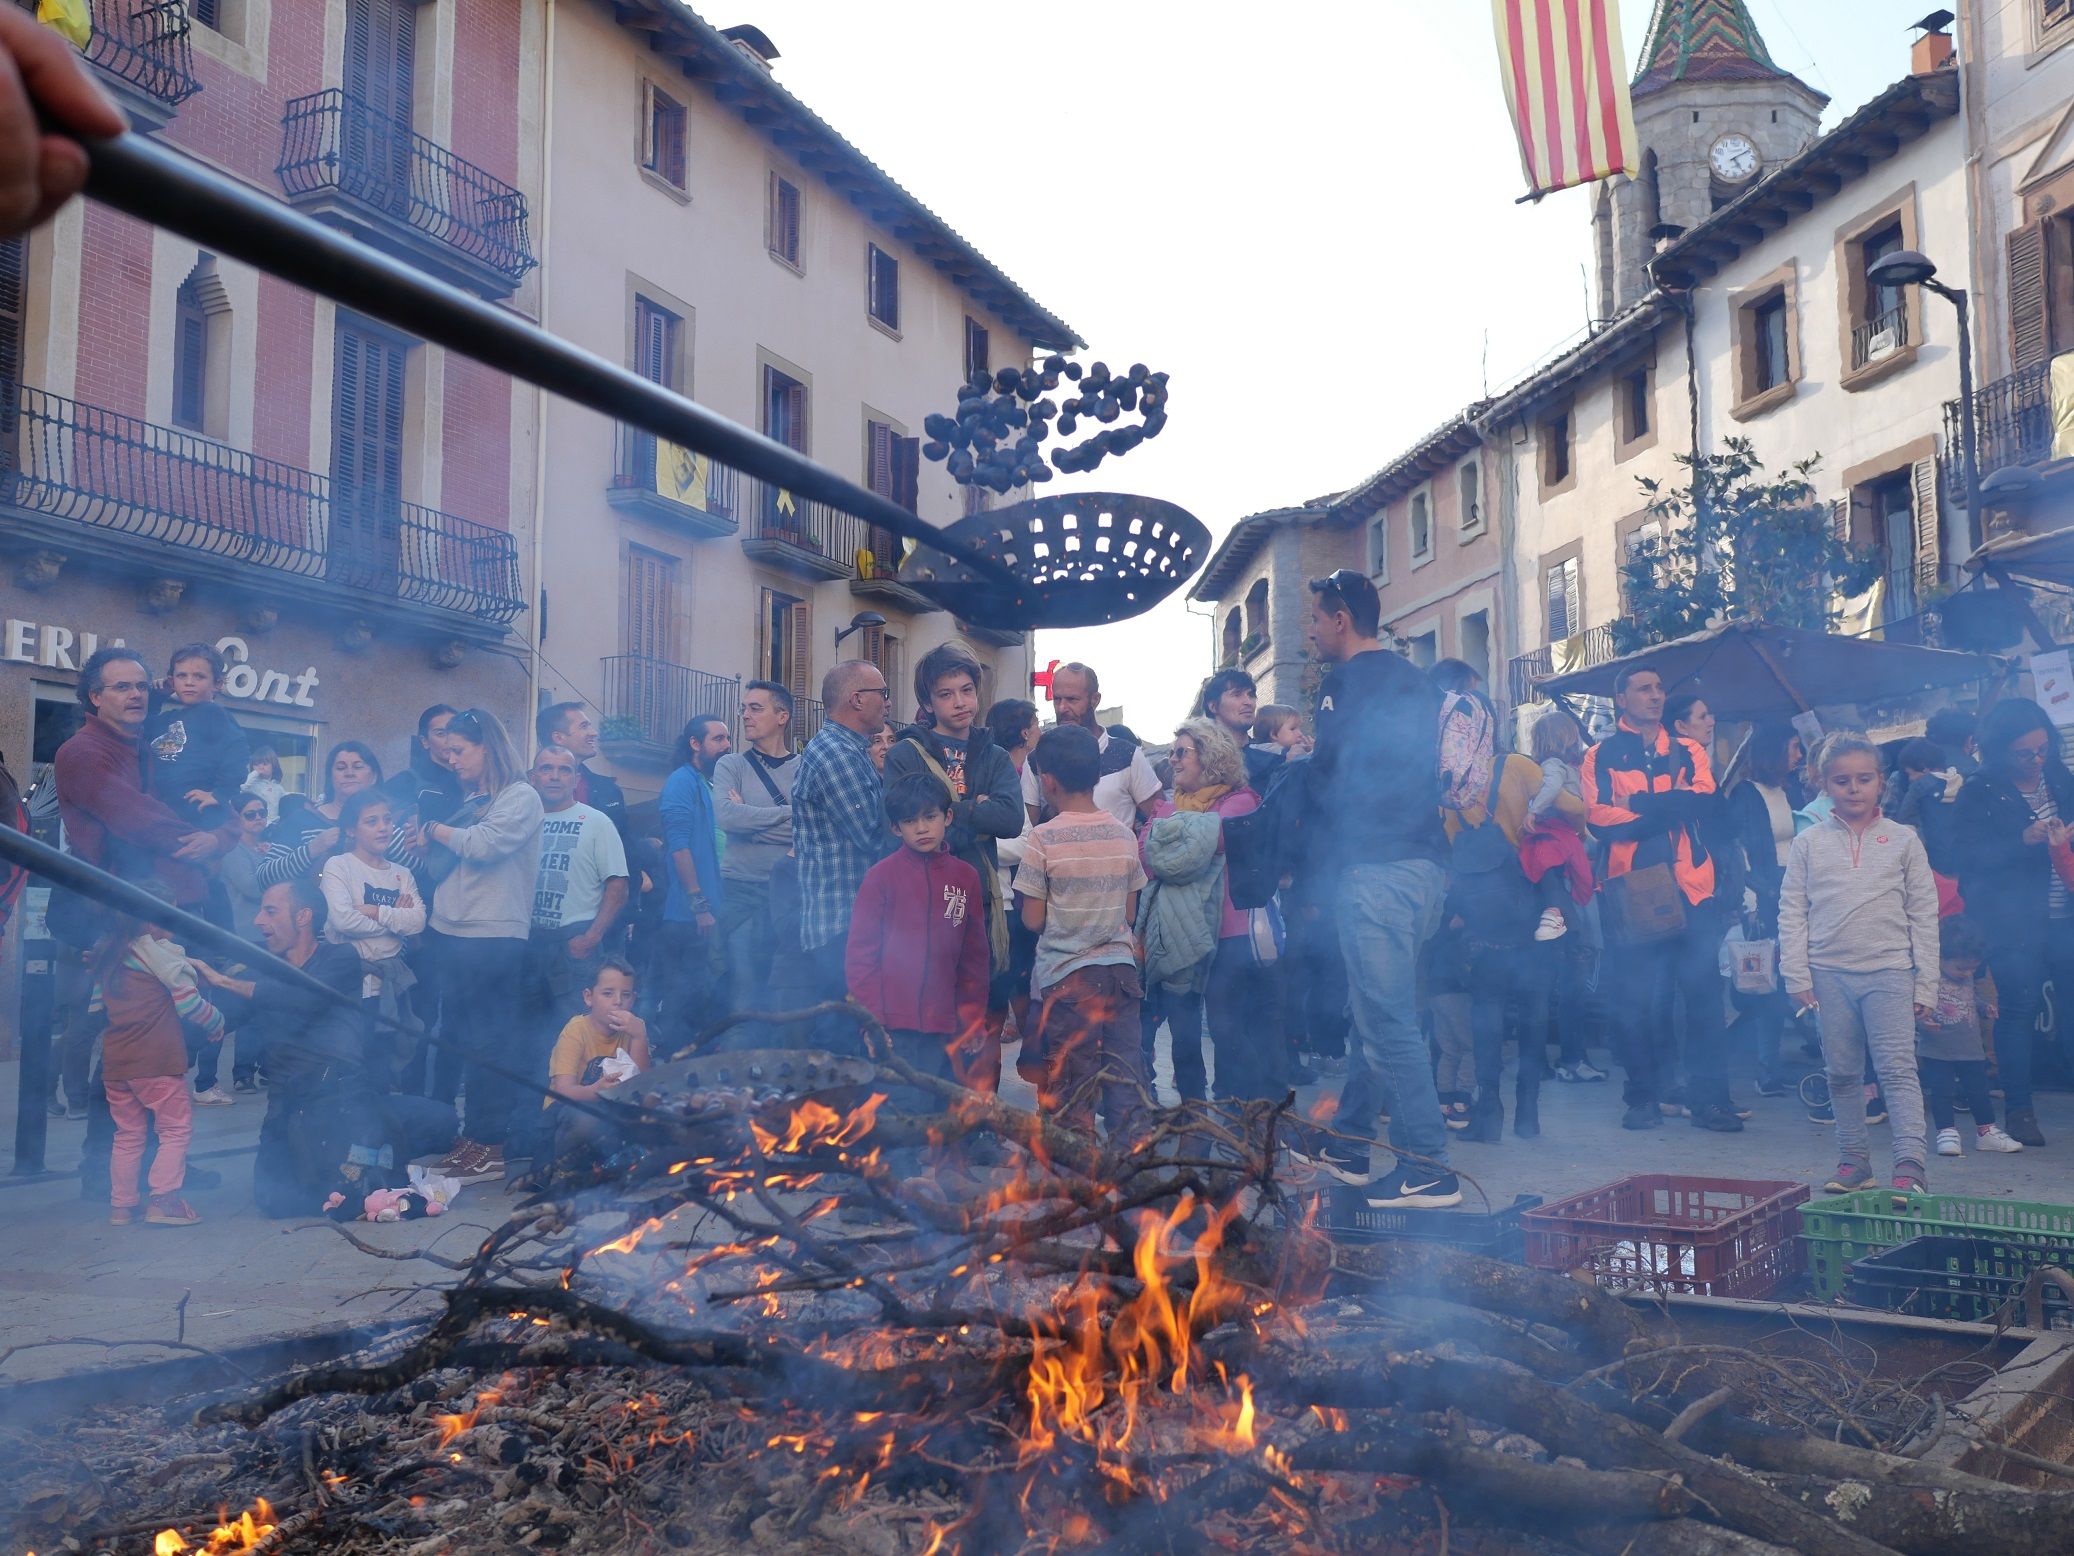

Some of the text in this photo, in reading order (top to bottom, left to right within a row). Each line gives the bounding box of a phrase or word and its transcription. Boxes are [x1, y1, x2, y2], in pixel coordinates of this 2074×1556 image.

[4, 618, 127, 672] ERI
[1320, 695, 1335, 711] A
[543, 820, 583, 835] COME
